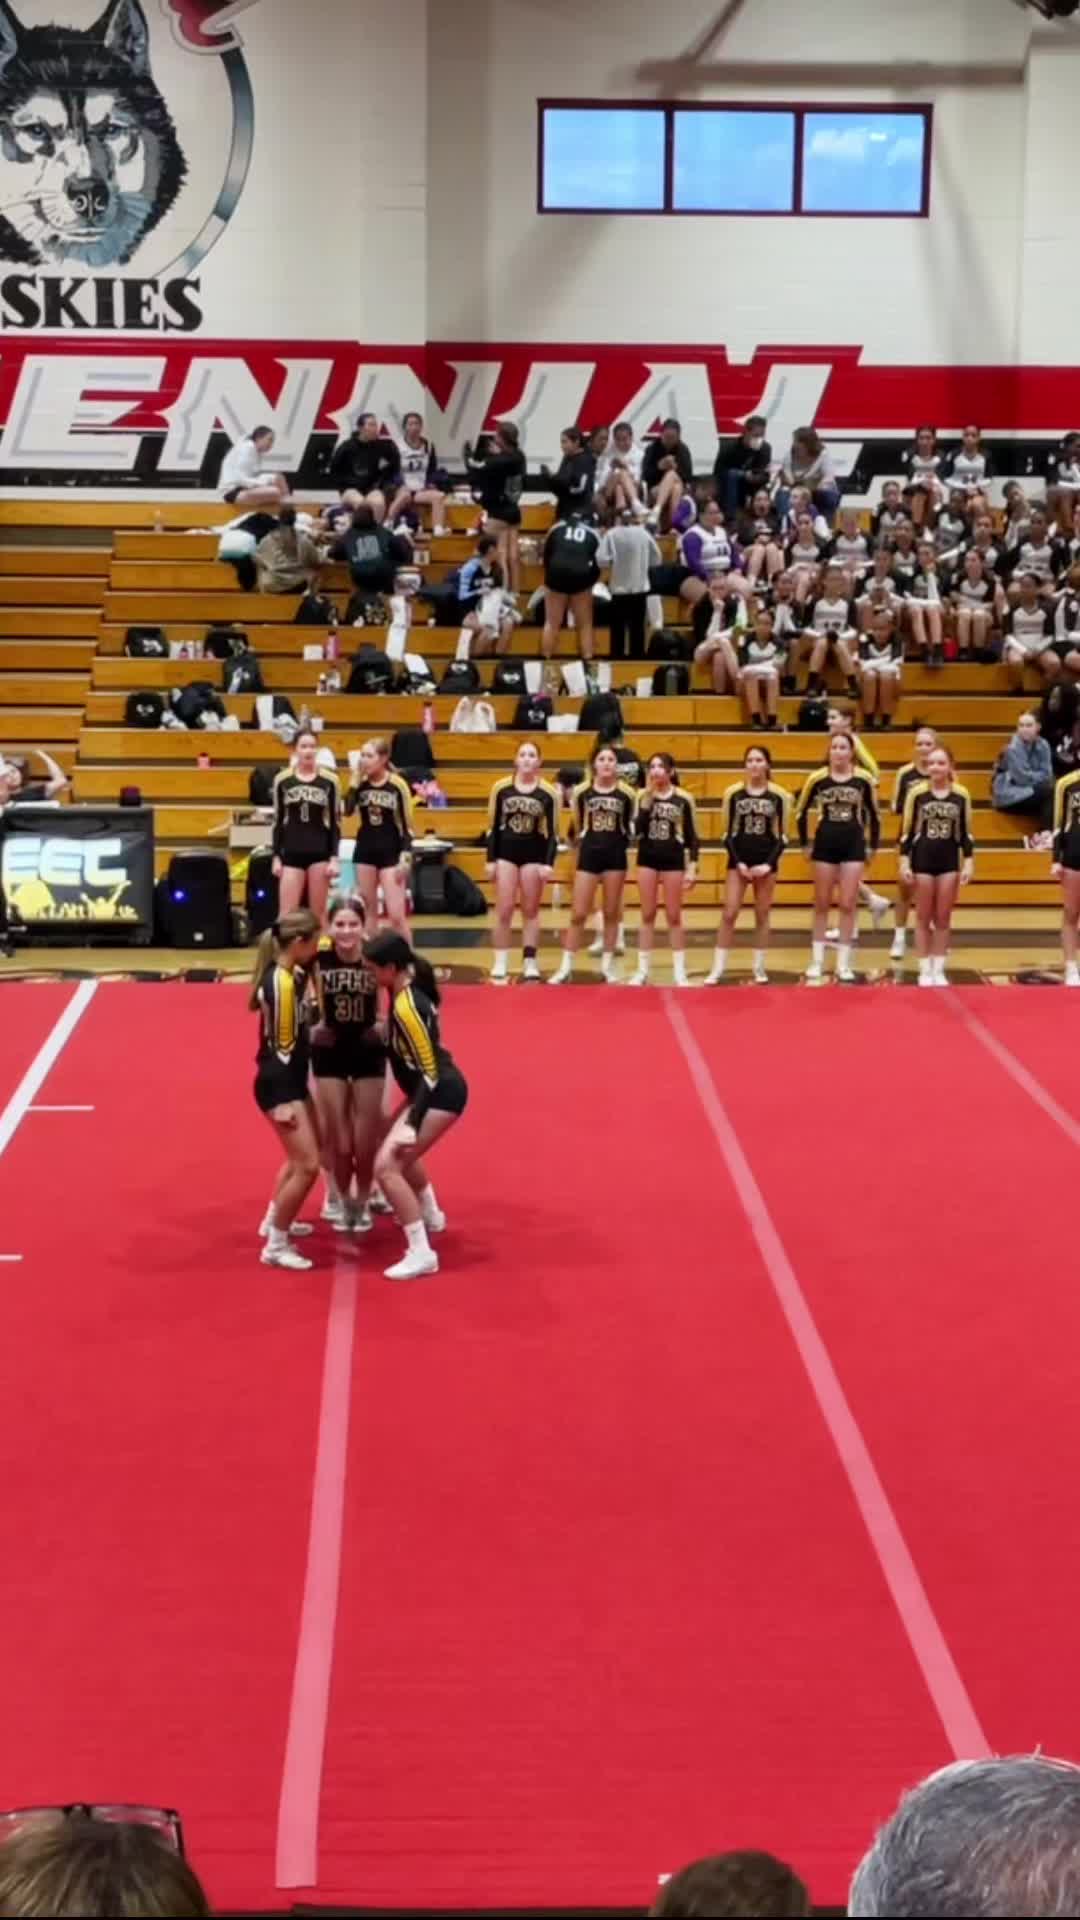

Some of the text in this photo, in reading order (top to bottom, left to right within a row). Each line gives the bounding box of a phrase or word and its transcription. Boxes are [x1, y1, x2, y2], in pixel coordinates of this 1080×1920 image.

[0, 273, 203, 332] SKIES
[564, 526, 587, 543] 10
[283, 785, 329, 807] NPHS
[319, 967, 377, 993] NPHS
[334, 994, 365, 1022] 31
